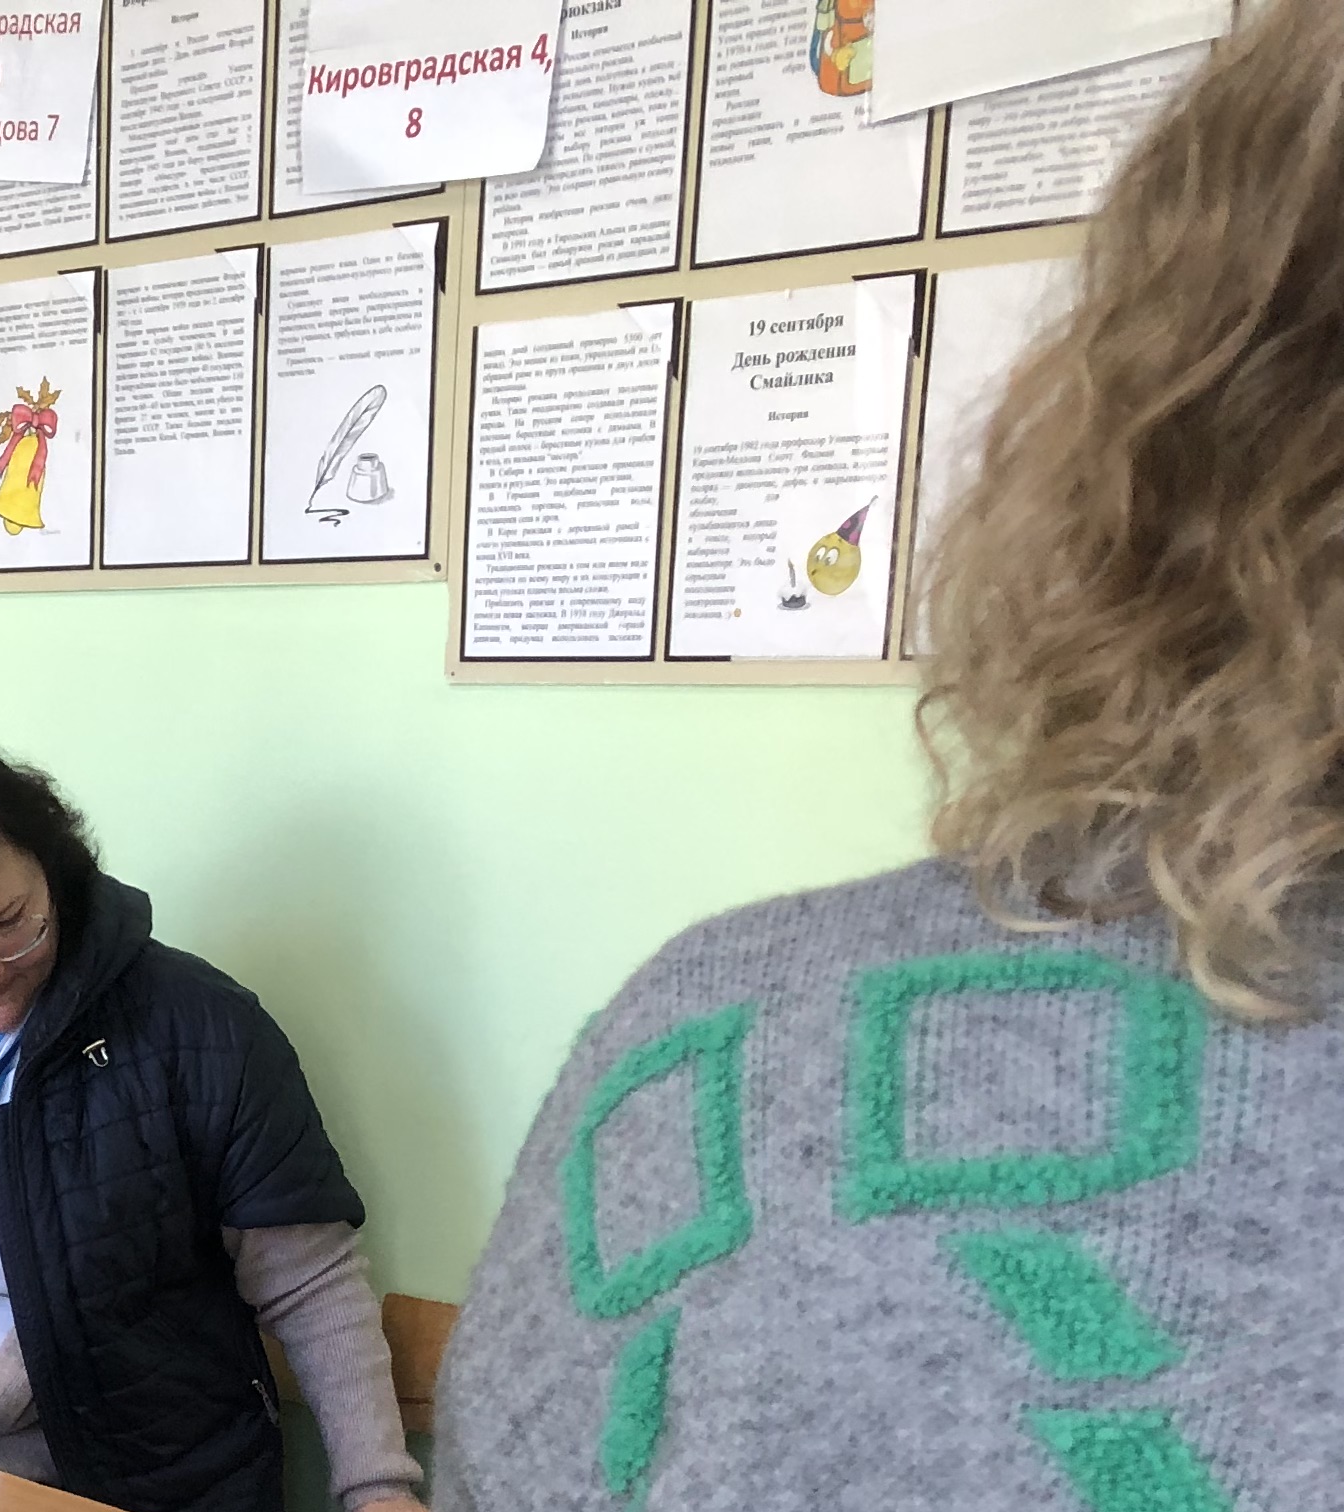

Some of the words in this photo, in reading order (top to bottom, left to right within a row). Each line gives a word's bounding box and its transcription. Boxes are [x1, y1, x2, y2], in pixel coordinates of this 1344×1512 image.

[308, 44, 522, 98] Кировградская
[531, 32, 553, 74] 4,
[47, 114, 60, 141] 7
[405, 106, 422, 138] 8
[749, 319, 766, 336] 19
[770, 313, 844, 335] сентября
[731, 352, 771, 371] День
[775, 344, 857, 368] рождения
[750, 371, 834, 391] Смайлика
[768, 409, 809, 422] История
